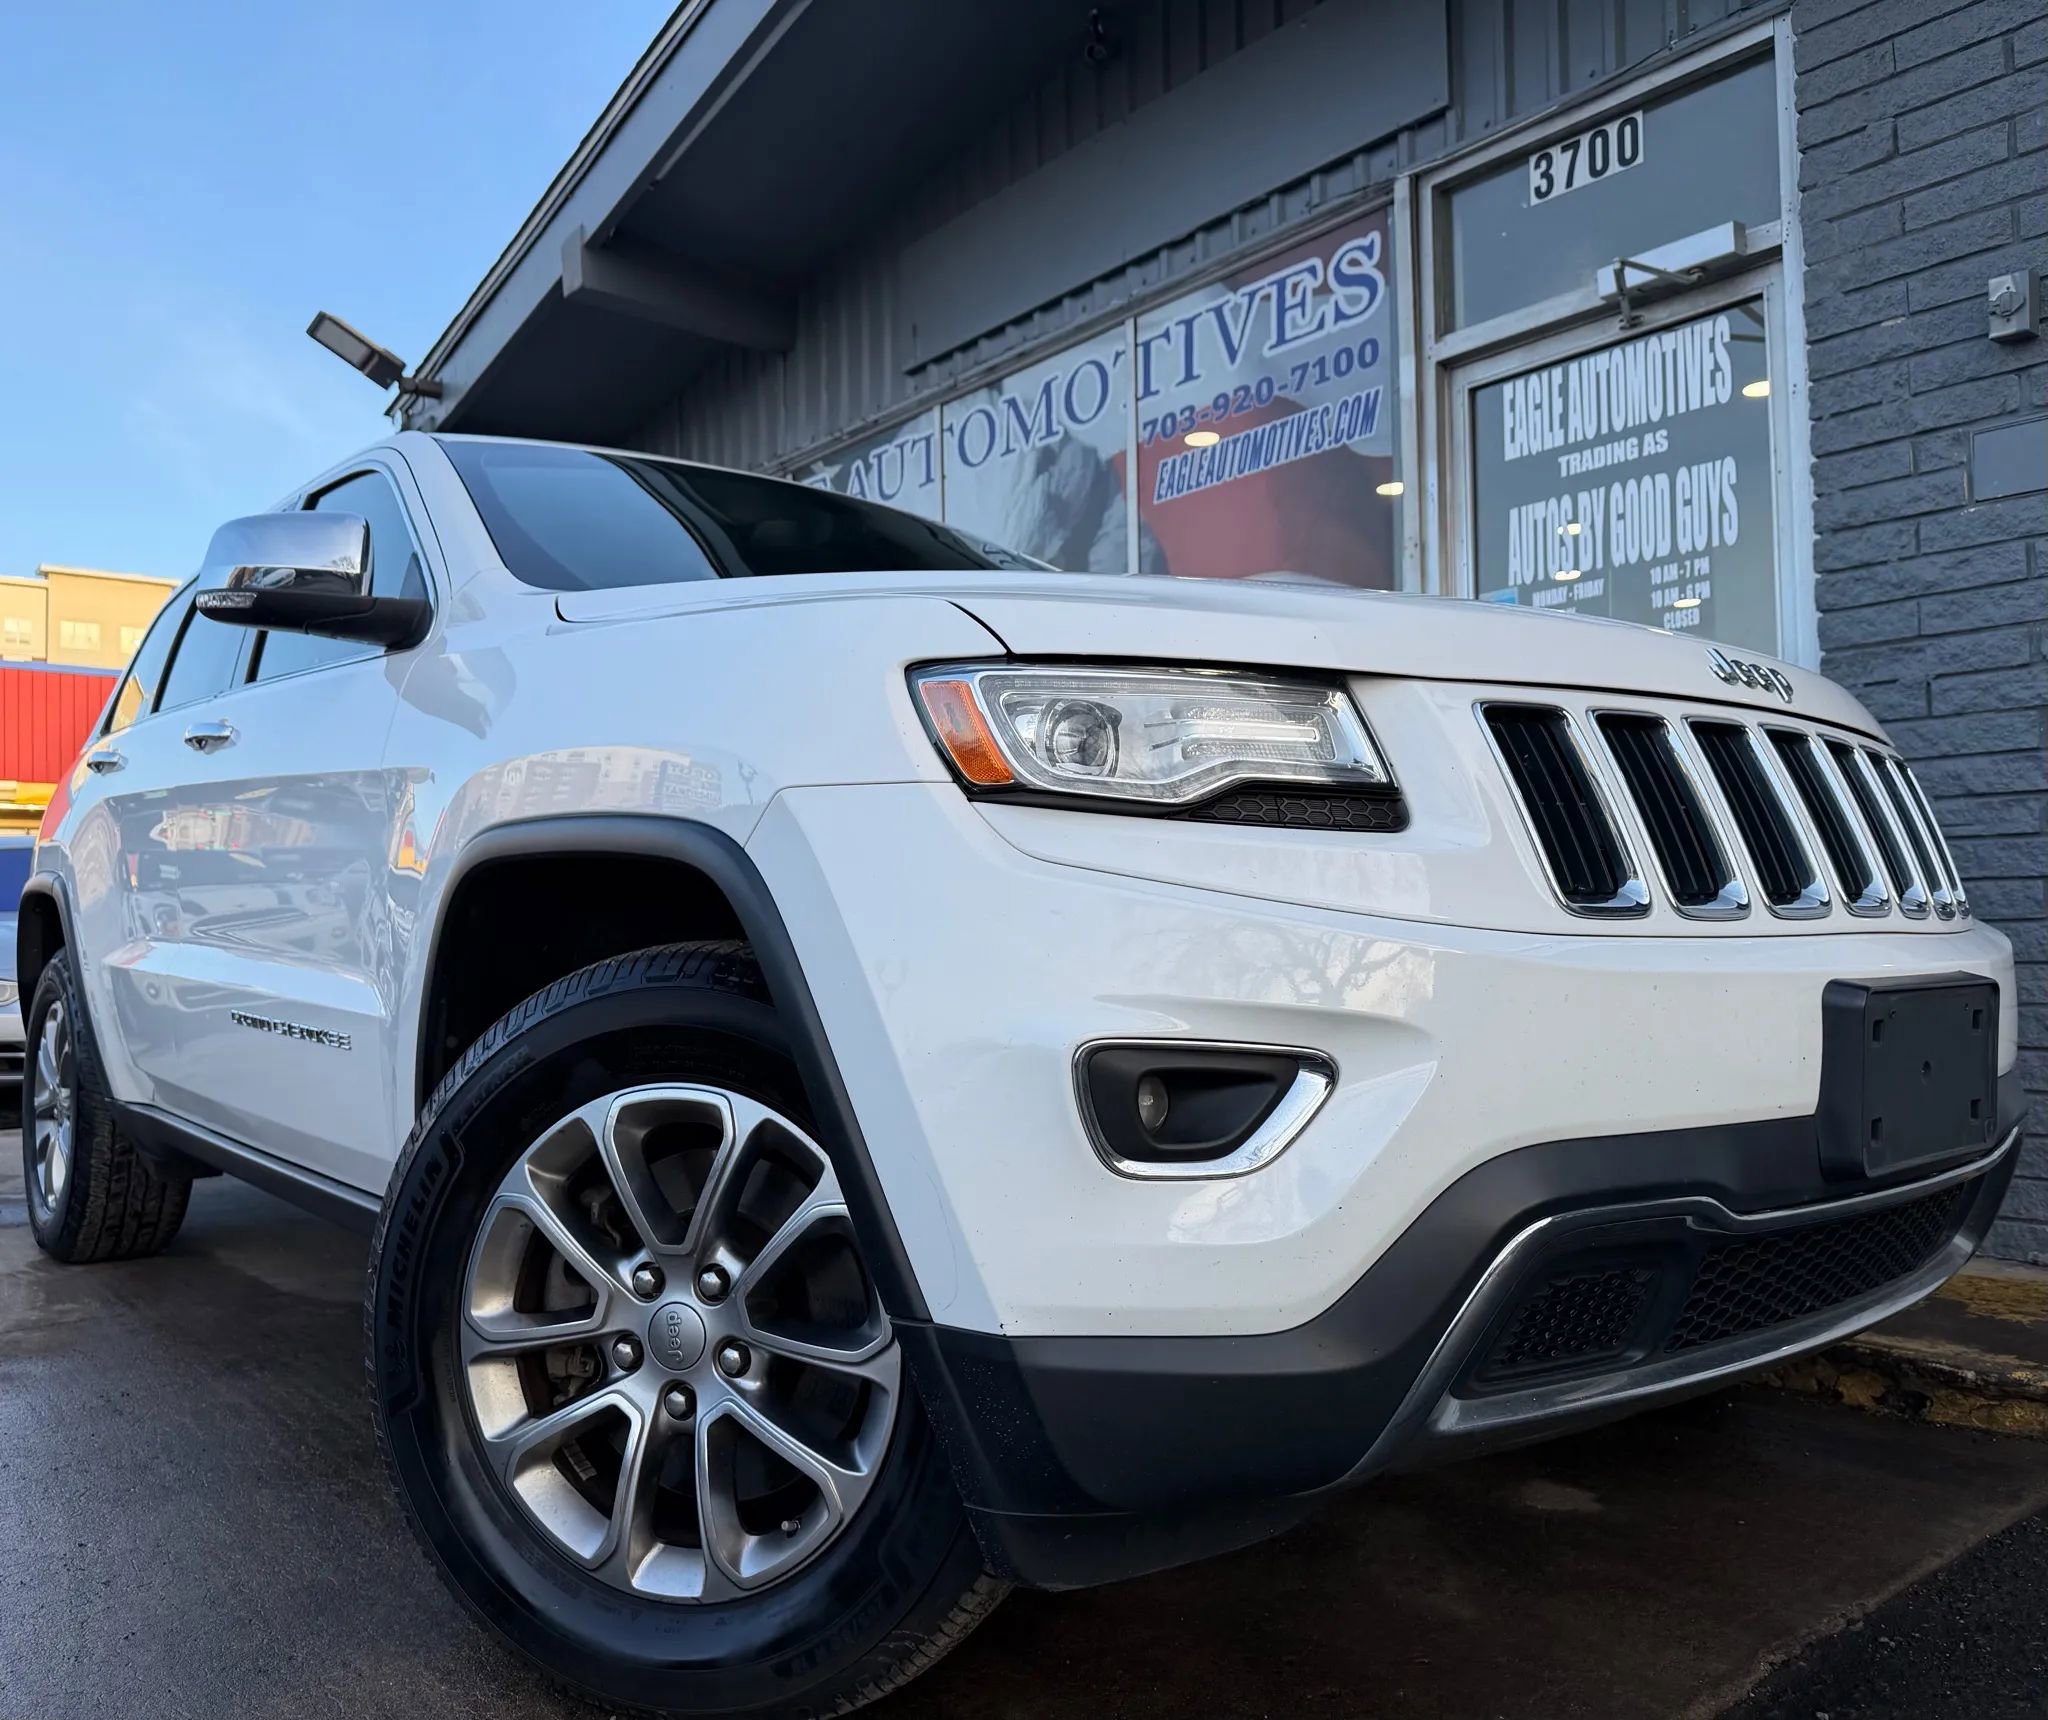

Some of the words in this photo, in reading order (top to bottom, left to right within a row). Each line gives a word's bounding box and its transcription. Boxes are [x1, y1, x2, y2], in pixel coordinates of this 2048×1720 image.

[1533, 116, 1640, 201] 3700
[848, 234, 1387, 502] AUTOMOTIVES
[1142, 337, 1380, 446] 703-920-7100
[1503, 370, 1564, 462] EAGLE
[1568, 315, 1733, 444] AUTOMOTIVES
[1154, 387, 1382, 503] EAGLEAUTOMOTIVES.COM
[1558, 437, 1638, 478] TRADING
[1643, 429, 1669, 459] AS
[1508, 494, 1574, 586] AUTOS
[1577, 486, 1606, 573] BY
[1609, 472, 1672, 568] GOOD
[1675, 456, 1739, 552] GUYS
[1663, 606, 1700, 630] CLOSED
[1705, 647, 1794, 704] Jeep
[387, 1153, 443, 1331] MICHELIN
[667, 1311, 683, 1361] Jeep
